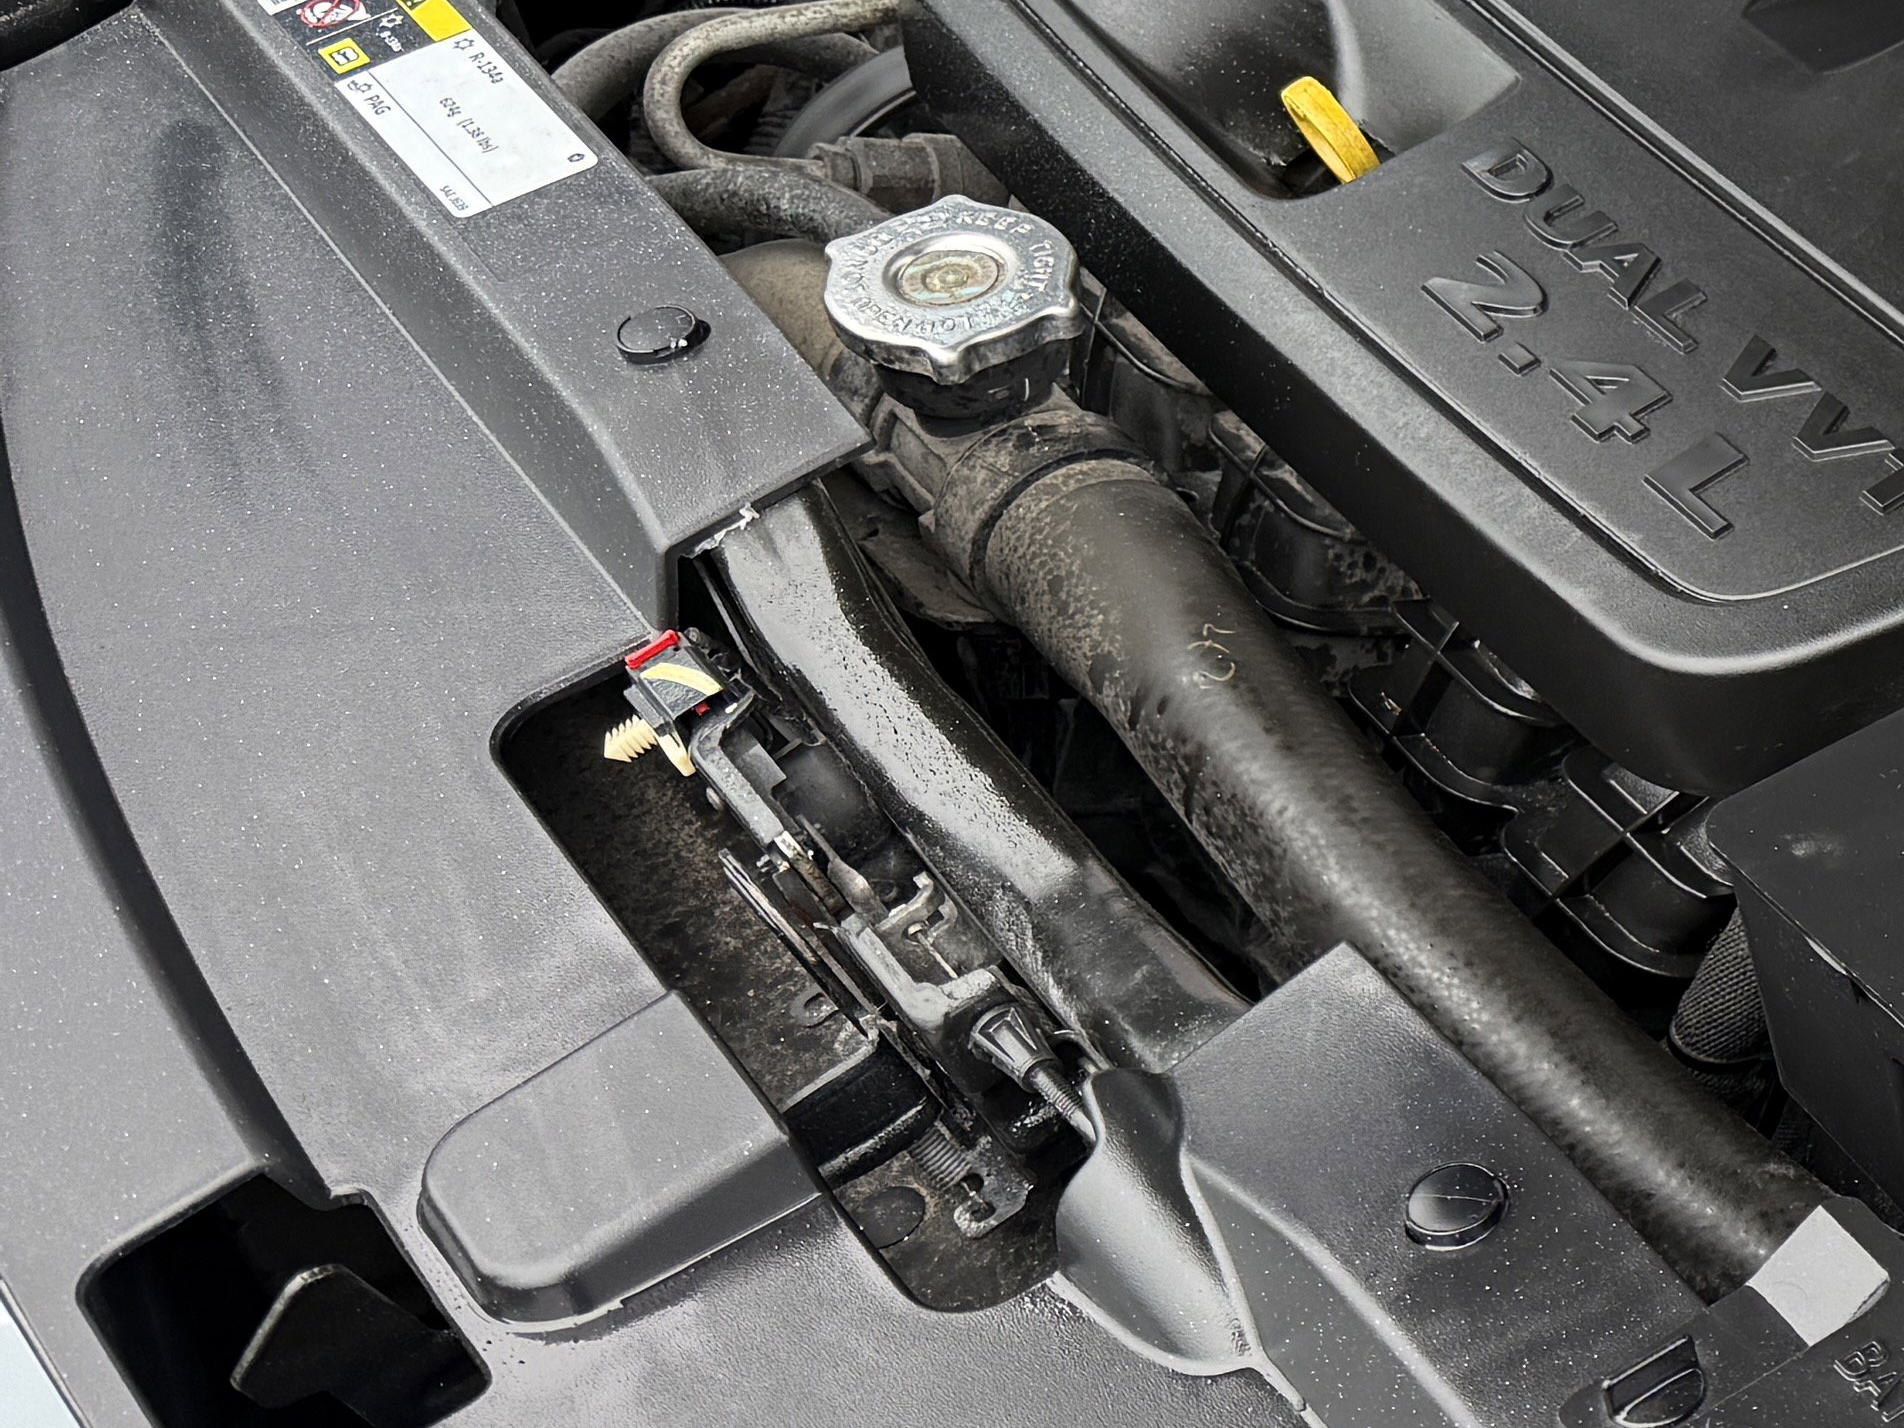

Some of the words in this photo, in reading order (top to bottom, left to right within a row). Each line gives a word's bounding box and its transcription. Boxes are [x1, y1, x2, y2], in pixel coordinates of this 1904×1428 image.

[365, 93, 391, 115] PAG
[956, 213, 1034, 234] KEEP
[1461, 138, 1708, 354] DUAL
